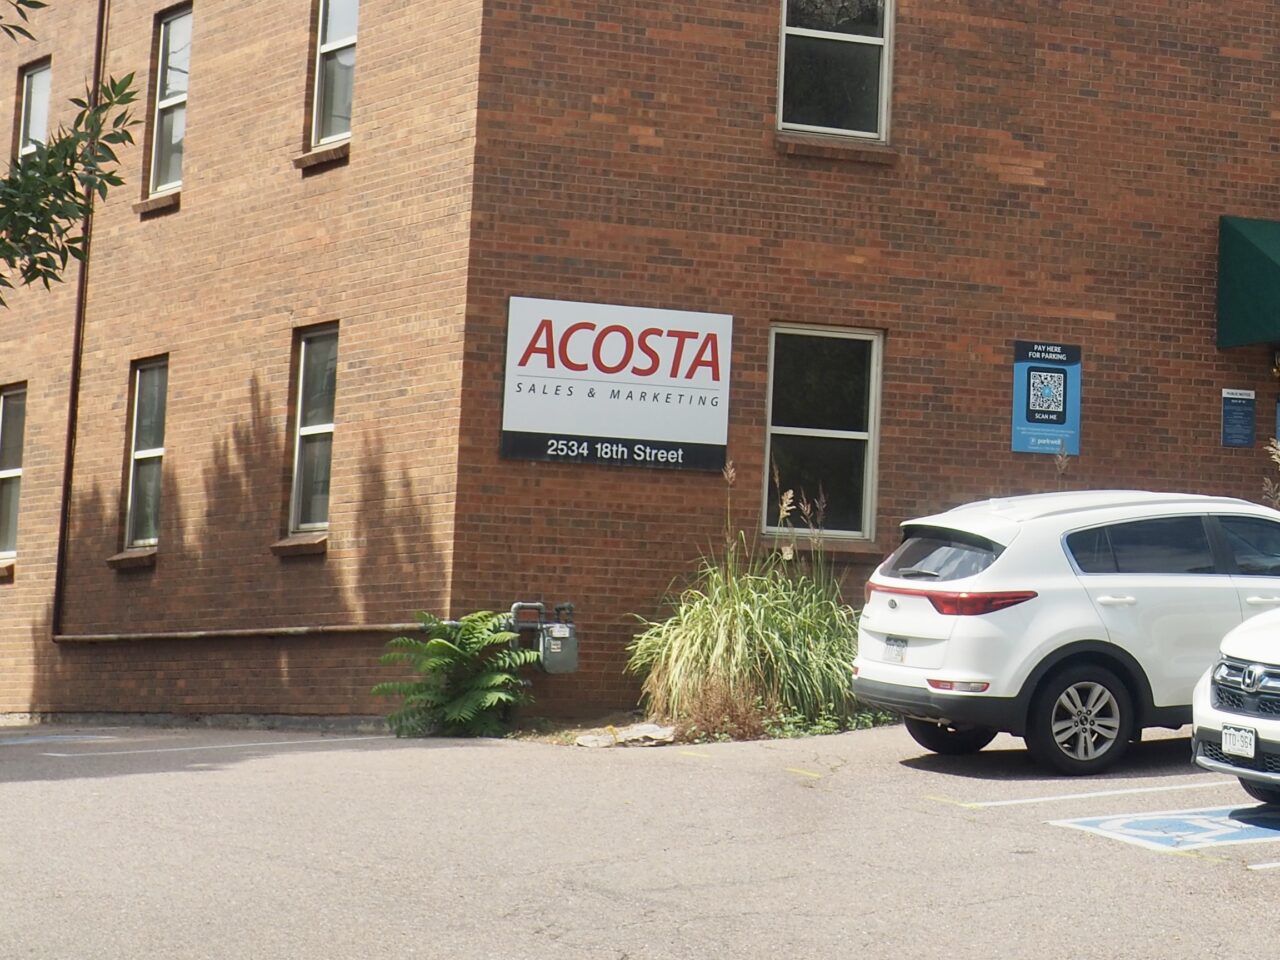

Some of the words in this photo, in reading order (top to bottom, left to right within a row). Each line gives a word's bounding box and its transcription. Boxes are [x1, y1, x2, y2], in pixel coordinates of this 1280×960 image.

[517, 319, 721, 382] ACOSTA
[1028, 351, 1041, 359] FOR
[1041, 352, 1067, 360] PARKING
[1034, 344, 1046, 352] PAY
[1046, 345, 1062, 353] HERE
[515, 382, 574, 397] SALES
[587, 387, 596, 398] &
[609, 389, 720, 408] MARKETING
[1035, 412, 1049, 420] SCAN
[547, 439, 589, 457] 2534
[594, 442, 628, 460] 18th
[633, 444, 684, 463] Street
